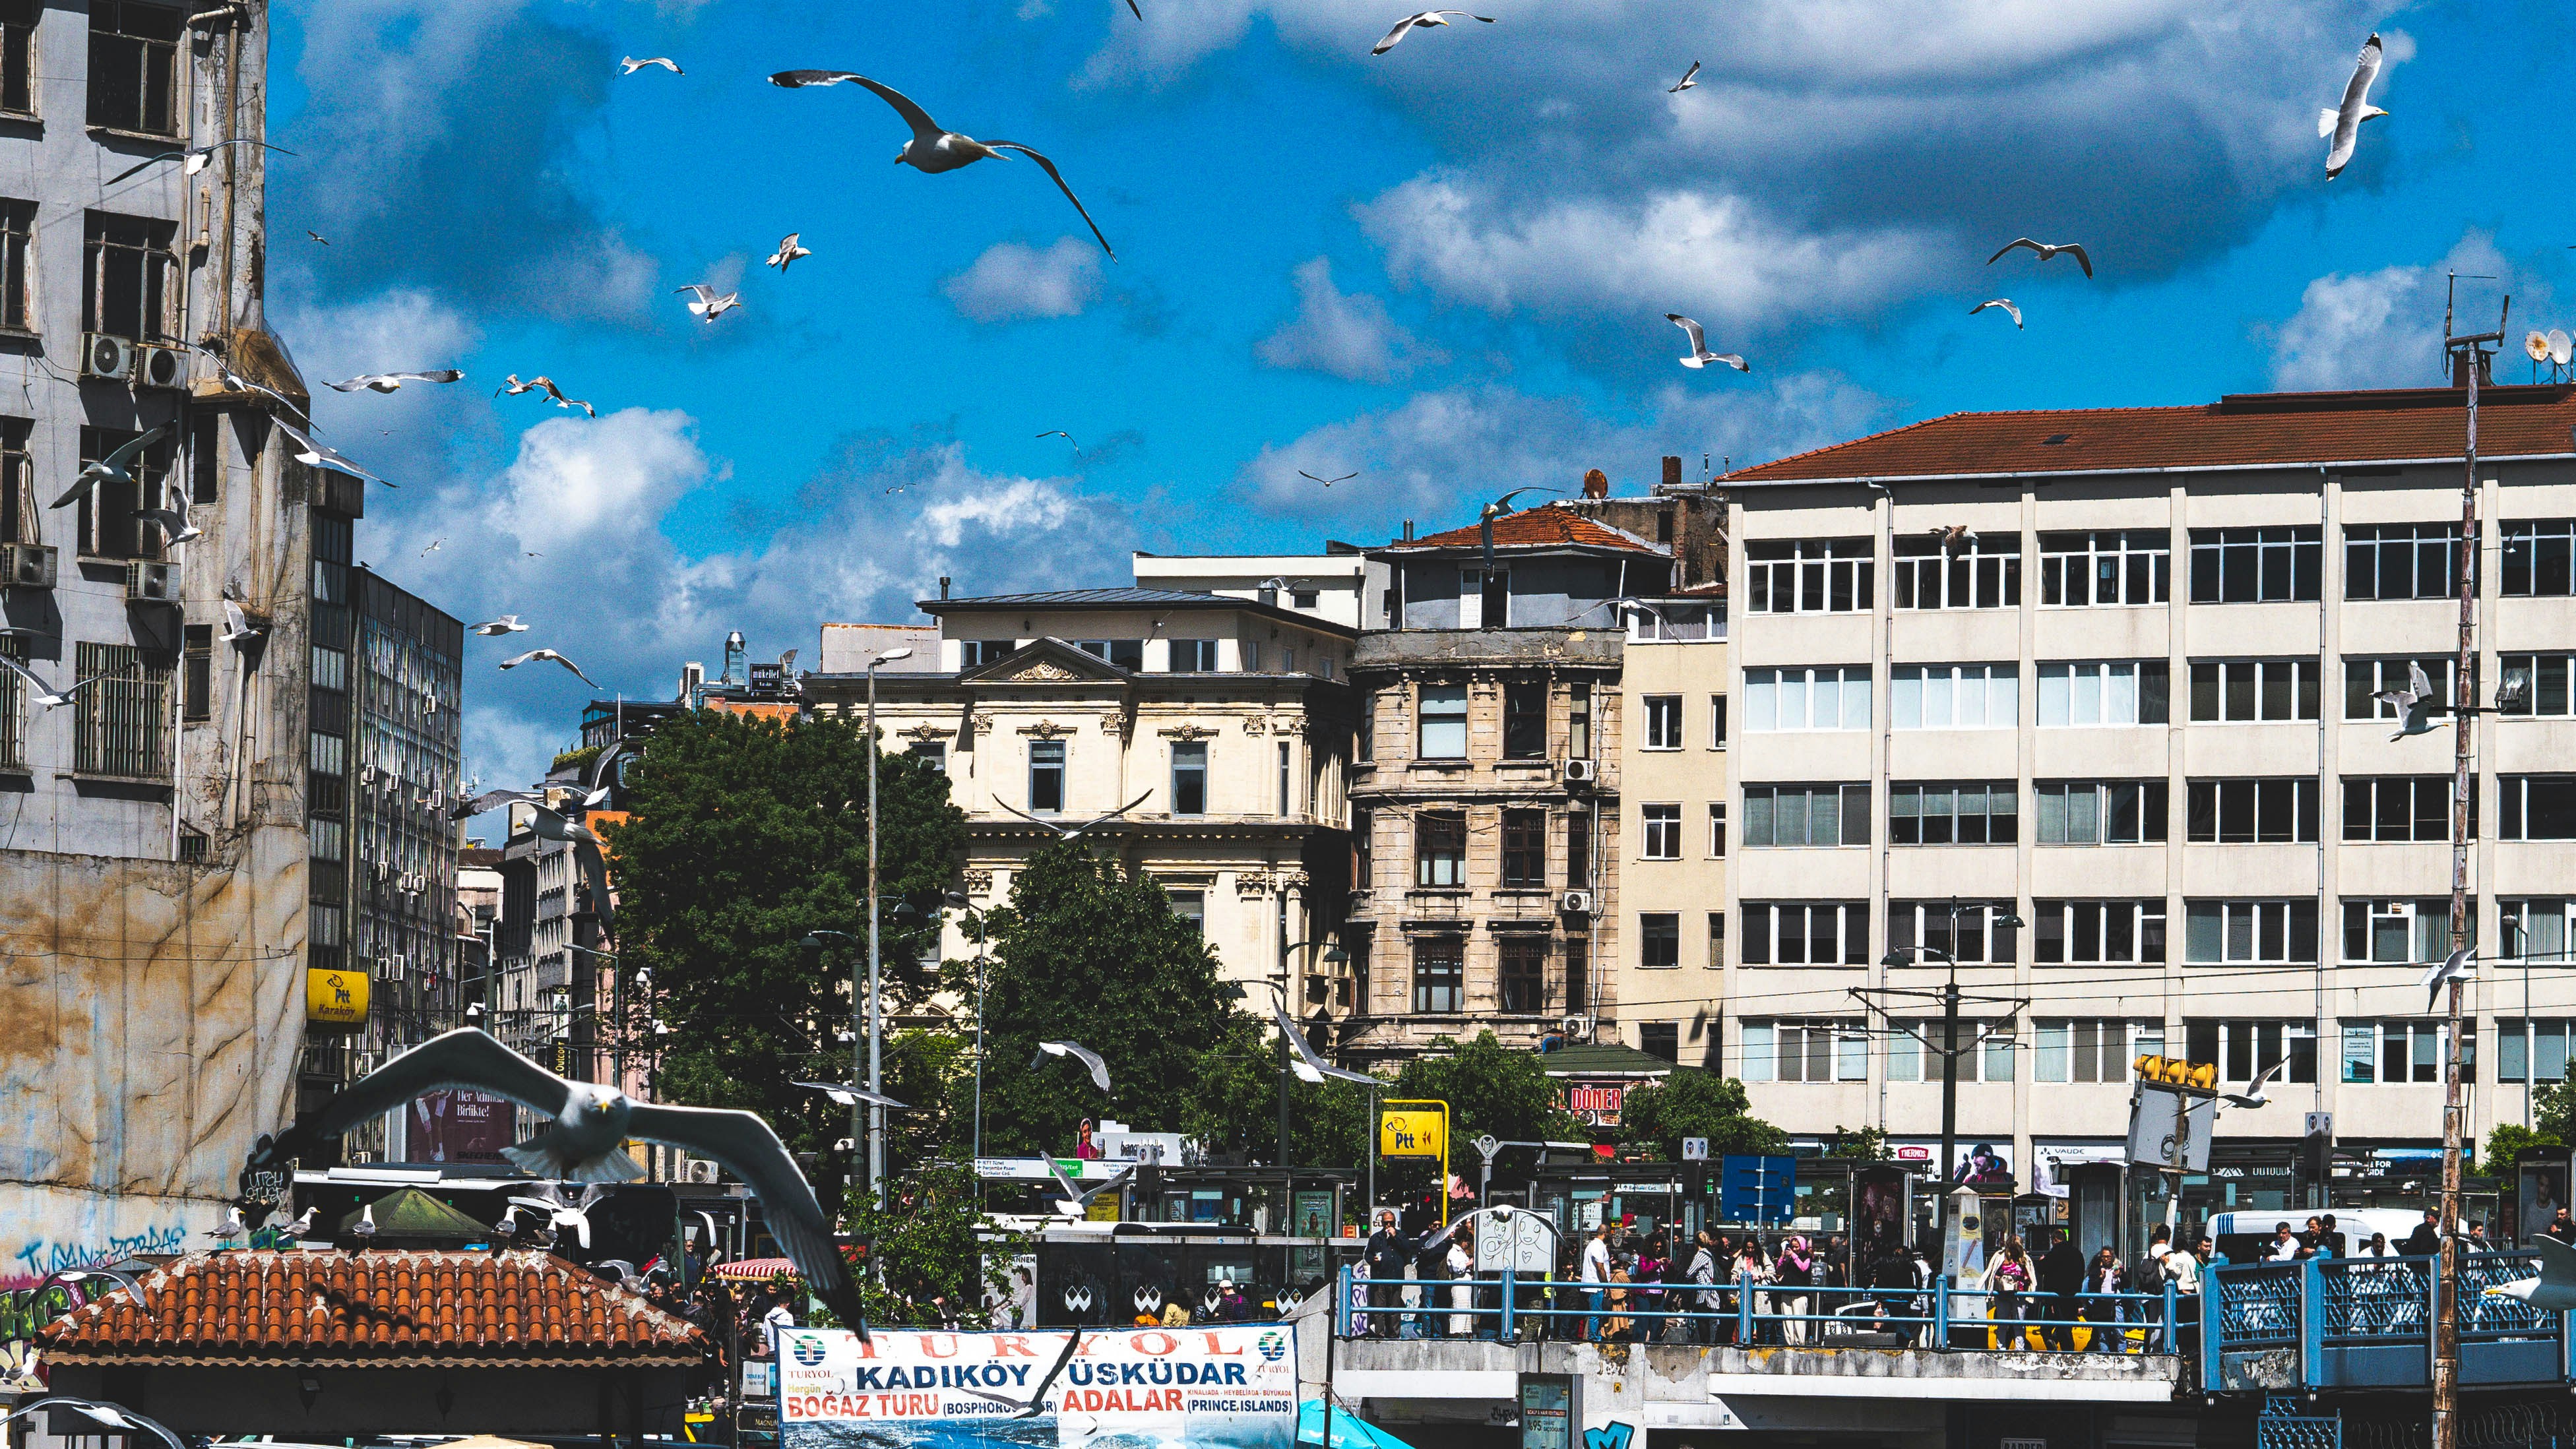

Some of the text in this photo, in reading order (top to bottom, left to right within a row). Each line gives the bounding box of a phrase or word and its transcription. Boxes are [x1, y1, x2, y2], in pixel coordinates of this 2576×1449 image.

[335, 989, 350, 1003] Ptt
[318, 1004, 356, 1020] Karaköy
[457, 1090, 473, 1102] Her
[1571, 1084, 1621, 1110] DÖNER
[457, 1104, 489, 1117] Birlikte!
[1395, 1132, 1415, 1149] Ptt
[1901, 1149, 1926, 1158] THERMOS
[845, 1332, 1243, 1359] TURYOL
[788, 1370, 834, 1378] TURYOL
[856, 1358, 1247, 1390] KADIKÖY ÜSKÜDAR
[1257, 1365, 1292, 1374] TURYOL
[788, 1384, 821, 1396] Hergün
[788, 1390, 938, 1417] BOĞAZ TURU
[1063, 1388, 1184, 1411] ADALAR
[1240, 1400, 1292, 1415] ISLANDS)
